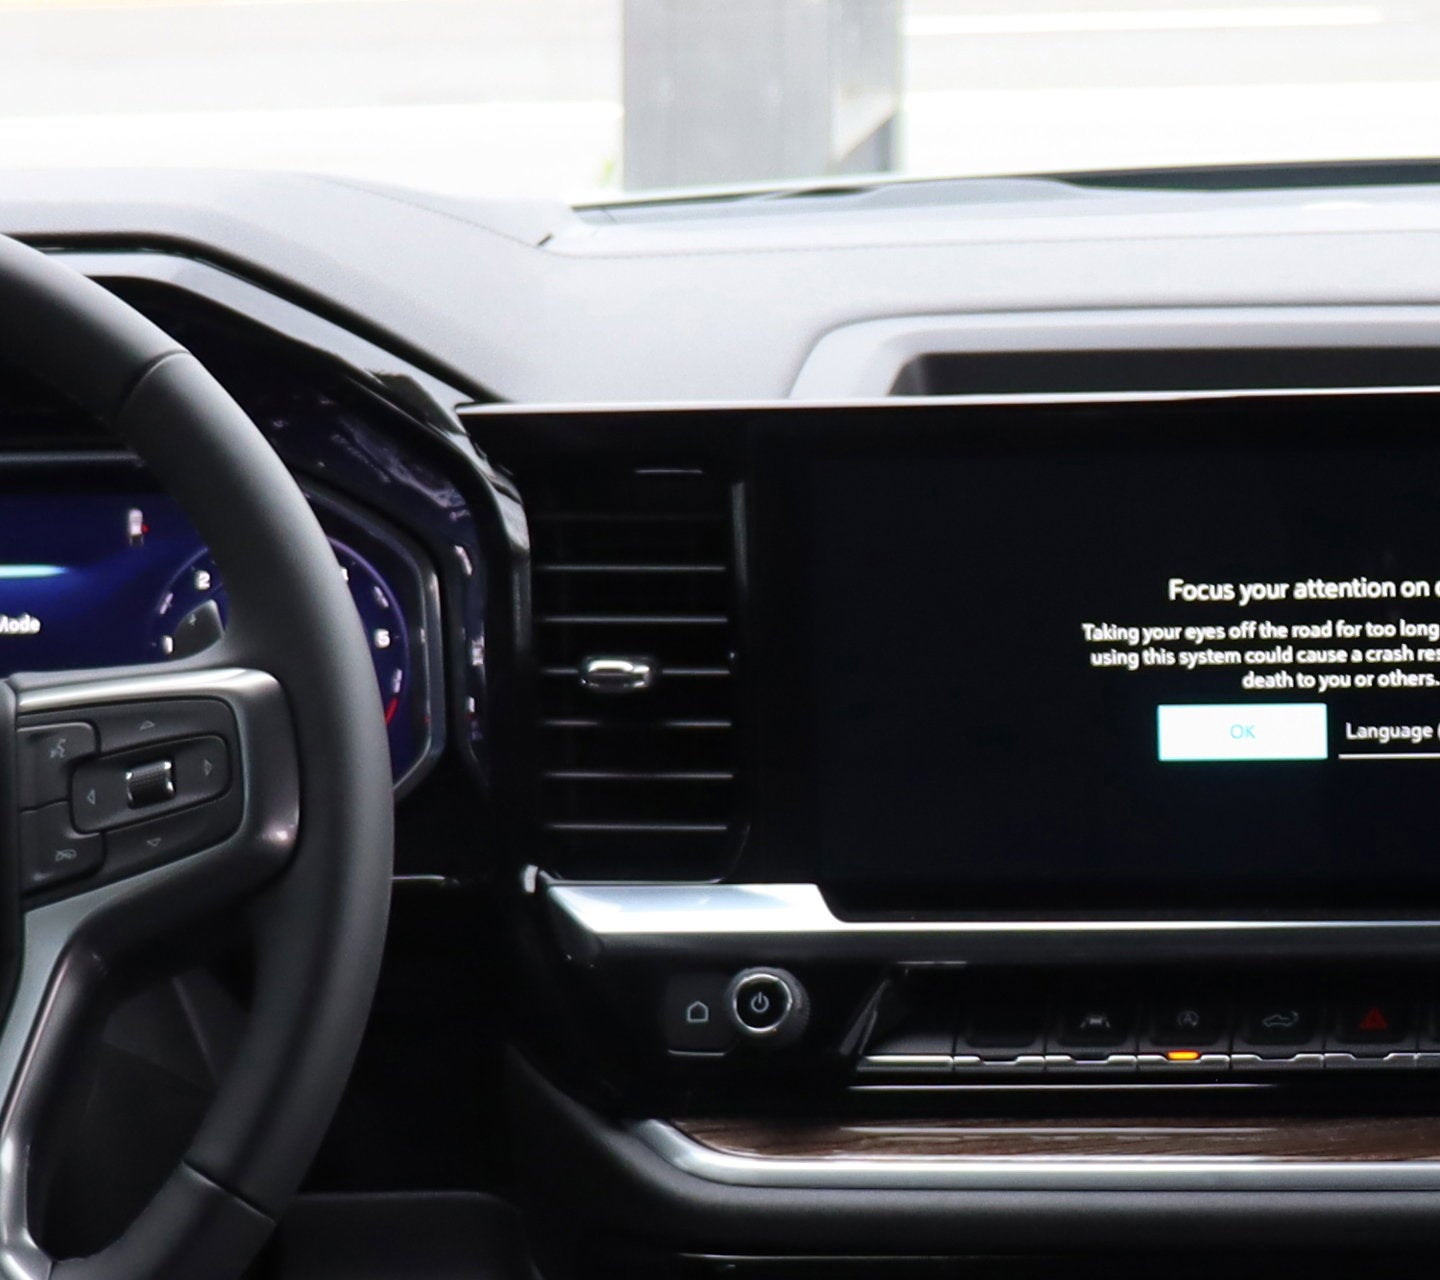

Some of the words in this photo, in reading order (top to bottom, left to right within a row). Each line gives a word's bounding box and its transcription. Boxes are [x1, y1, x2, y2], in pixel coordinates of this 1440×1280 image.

[196, 570, 211, 590] 2
[1168, 578, 1235, 600] Focus
[1238, 582, 1288, 605] your
[1293, 577, 1396, 599] attention
[1399, 580, 1430, 597] on
[1081, 623, 1139, 645] Taking
[1141, 626, 1181, 644] your
[1184, 626, 1225, 644] eyes
[1227, 620, 1257, 639] off
[1258, 620, 1288, 638] the
[1291, 620, 1332, 638] road
[1335, 619, 1362, 637] for
[1365, 621, 1396, 637] too
[1399, 618, 1440, 641] long
[1090, 644, 1139, 670] using
[1141, 644, 1175, 665] this
[1178, 649, 1241, 669] system
[1243, 645, 1293, 663] could
[1295, 649, 1347, 663] cause
[1350, 649, 1362, 662] a
[1364, 643, 1414, 662] crash
[1241, 670, 1293, 688] death
[1295, 672, 1316, 688] to
[1318, 674, 1351, 692] you
[1353, 674, 1374, 687] or
[1376, 669, 1439, 687] others.
[1229, 723, 1257, 740] OK
[1345, 723, 1433, 743] Language
